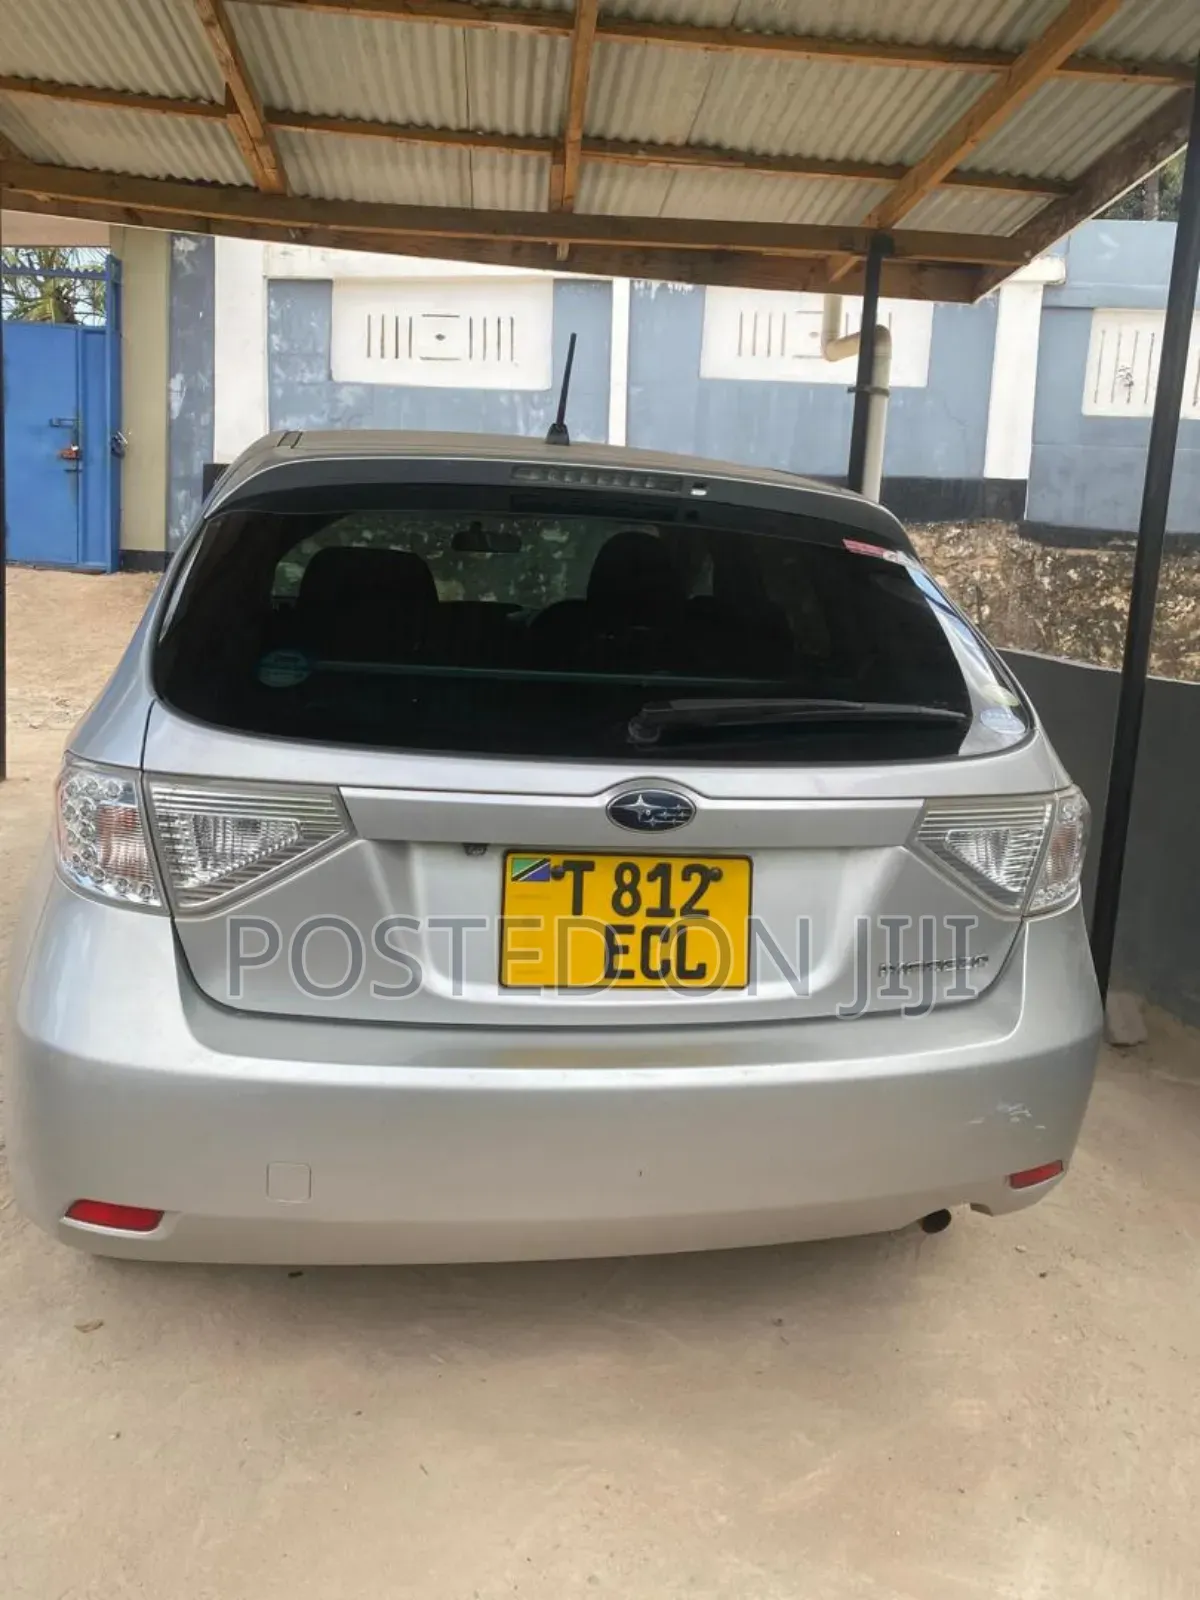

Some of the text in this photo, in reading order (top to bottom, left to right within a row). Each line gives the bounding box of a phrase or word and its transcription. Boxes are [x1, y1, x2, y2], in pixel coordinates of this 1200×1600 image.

[562, 860, 710, 918] T 812
[604, 924, 707, 980] ECL
